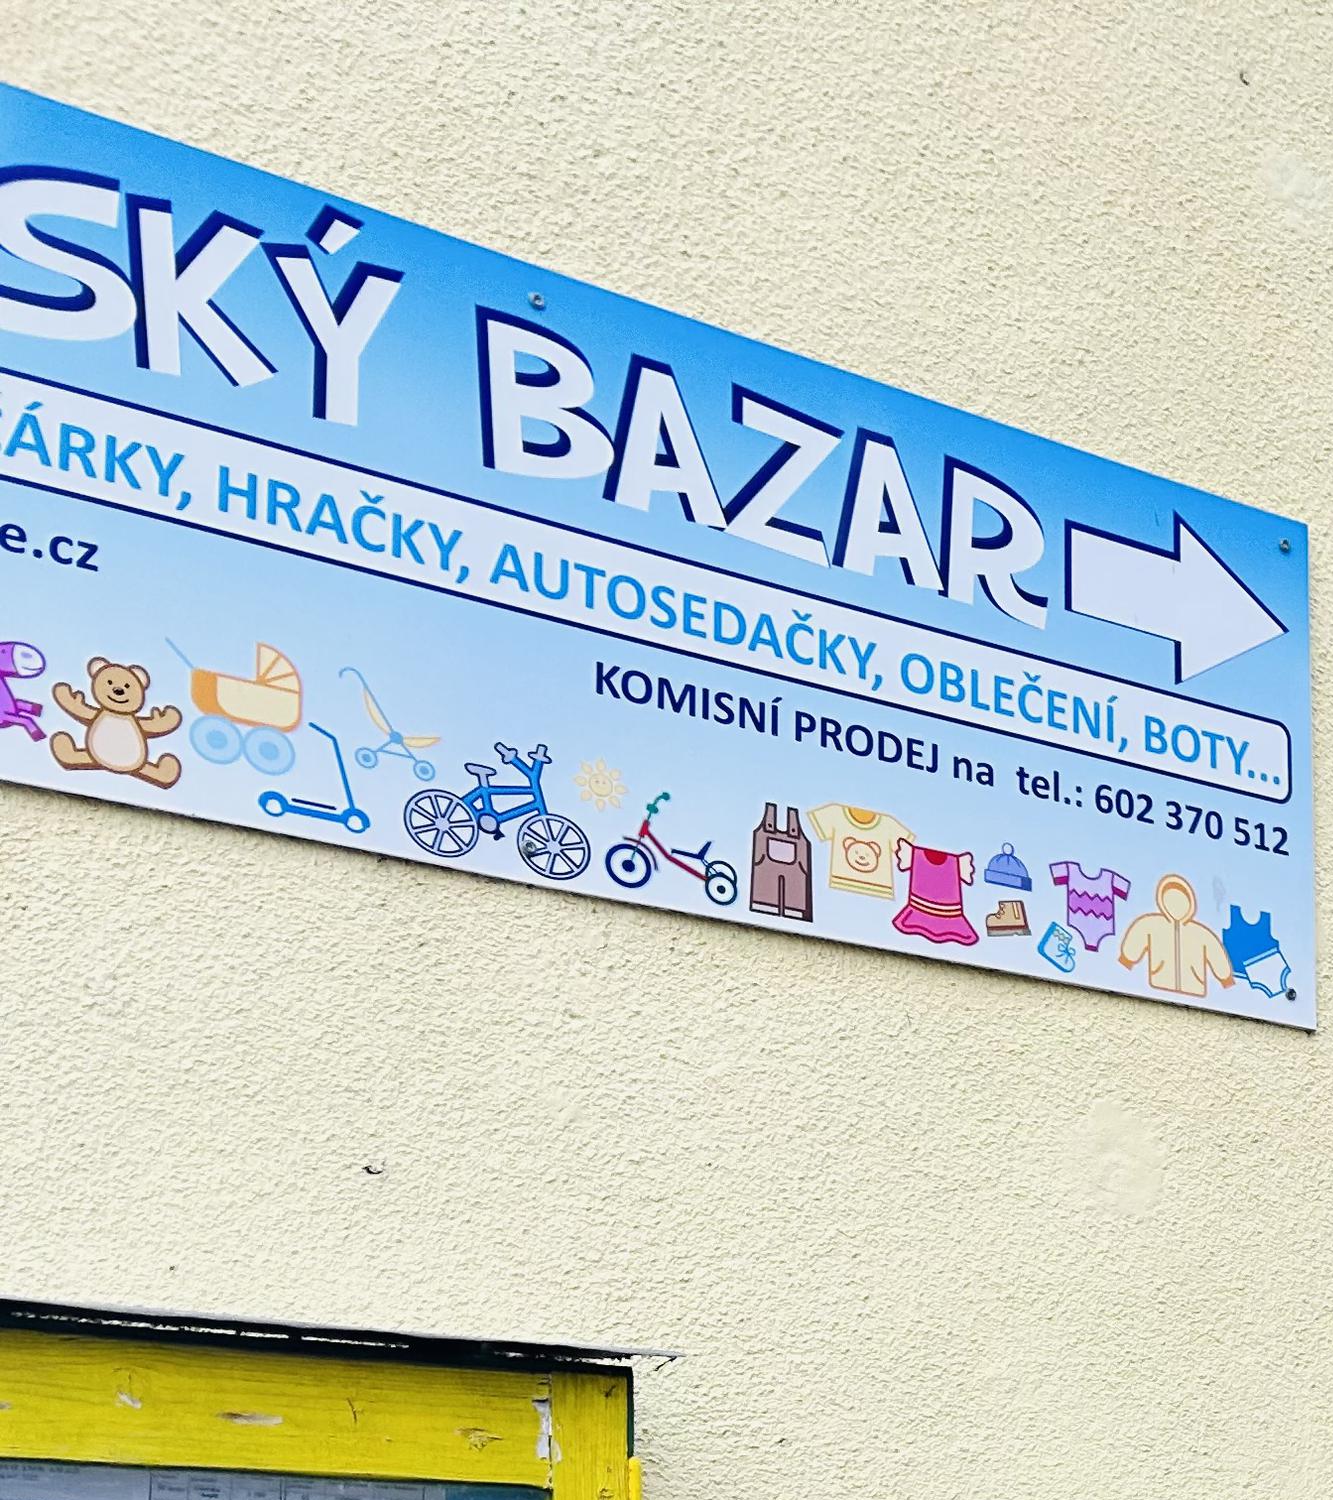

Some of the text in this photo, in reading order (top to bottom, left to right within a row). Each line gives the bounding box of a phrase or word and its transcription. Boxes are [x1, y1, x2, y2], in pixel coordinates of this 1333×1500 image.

[0, 164, 1048, 631] SKÝ BAZAR
[0, 523, 99, 572] e.cz
[0, 392, 1282, 787] ÁRKY, HRAČKY, AUTOSEDAČKY, OBLEČENÍ, BOTY...
[594, 661, 1290, 857] KOMISNÍ PRODEJ na tel.: 602 370 512
